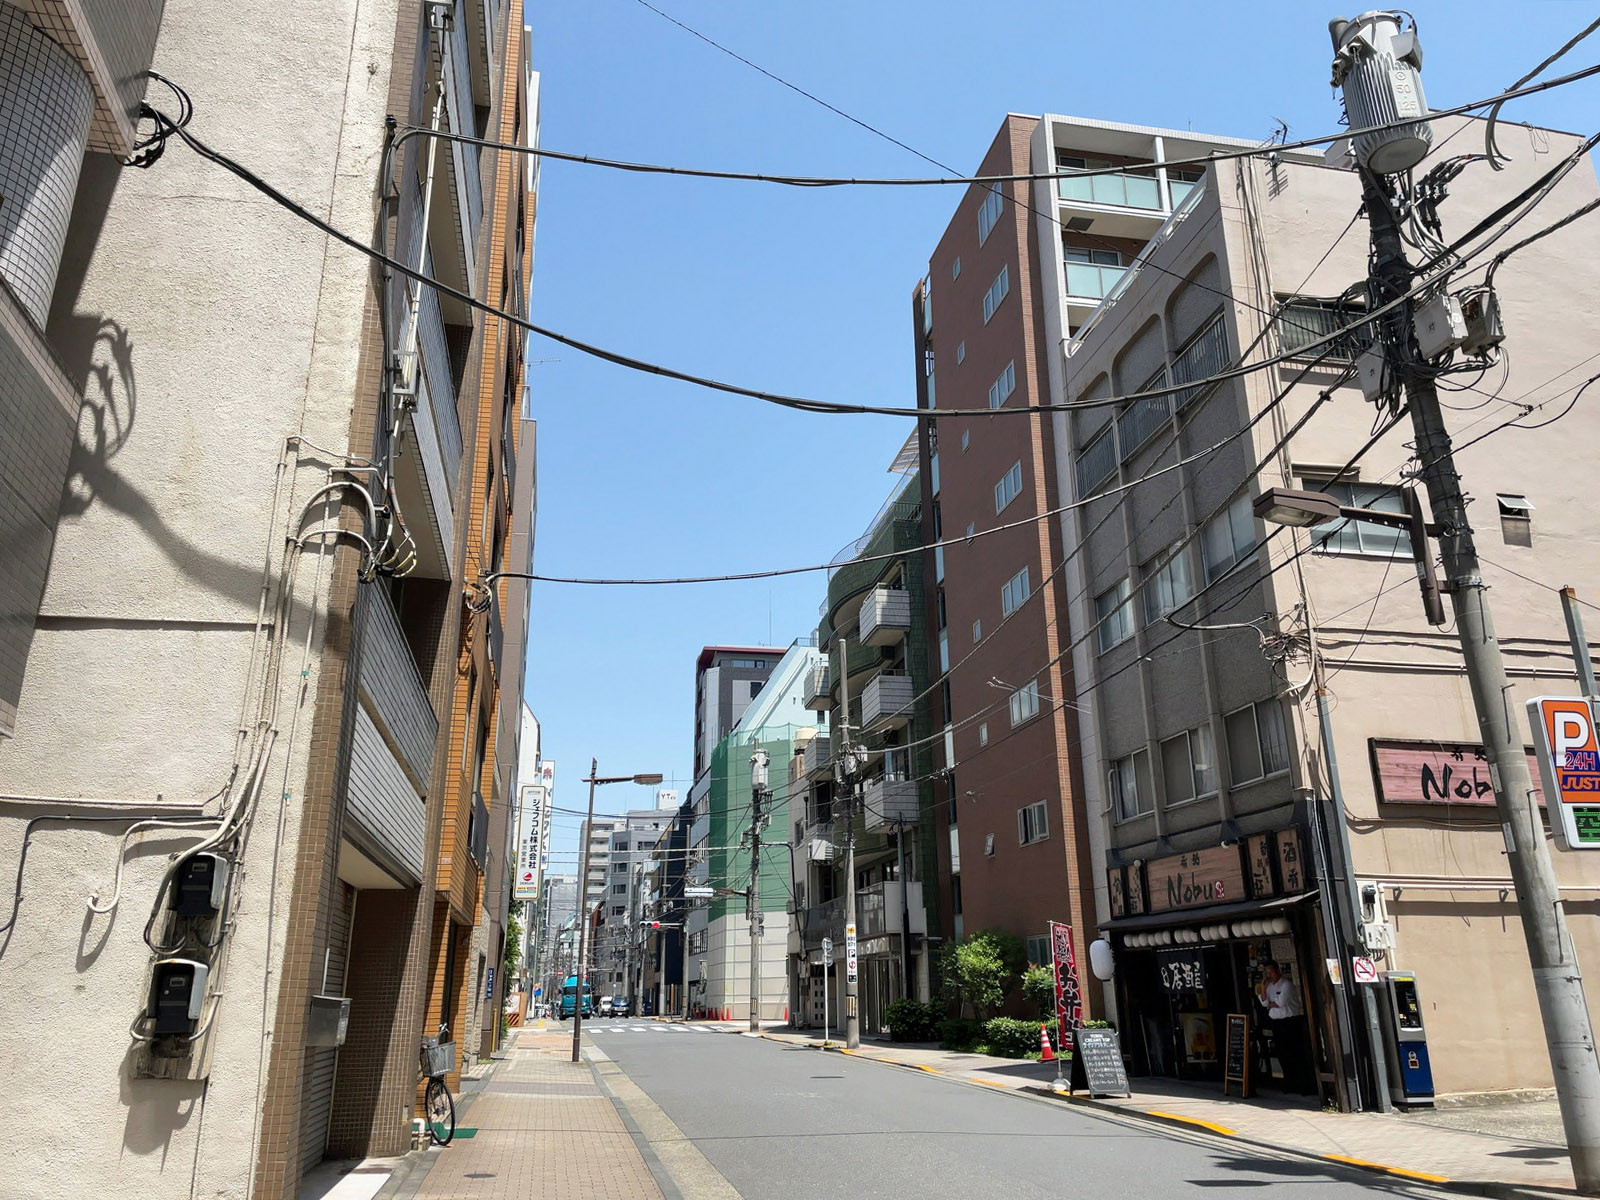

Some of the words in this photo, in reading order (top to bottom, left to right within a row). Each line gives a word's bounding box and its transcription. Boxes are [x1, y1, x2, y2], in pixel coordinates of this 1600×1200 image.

[1396, 84, 1411, 94] 50
[1553, 711, 1590, 767] P
[1564, 752, 1595, 770] 24H
[1421, 763, 1492, 800] Nob
[1562, 776, 1600, 790] JUST
[528, 798, 541, 869] ジェフコム株式会社
[1167, 871, 1213, 909] Nobu
